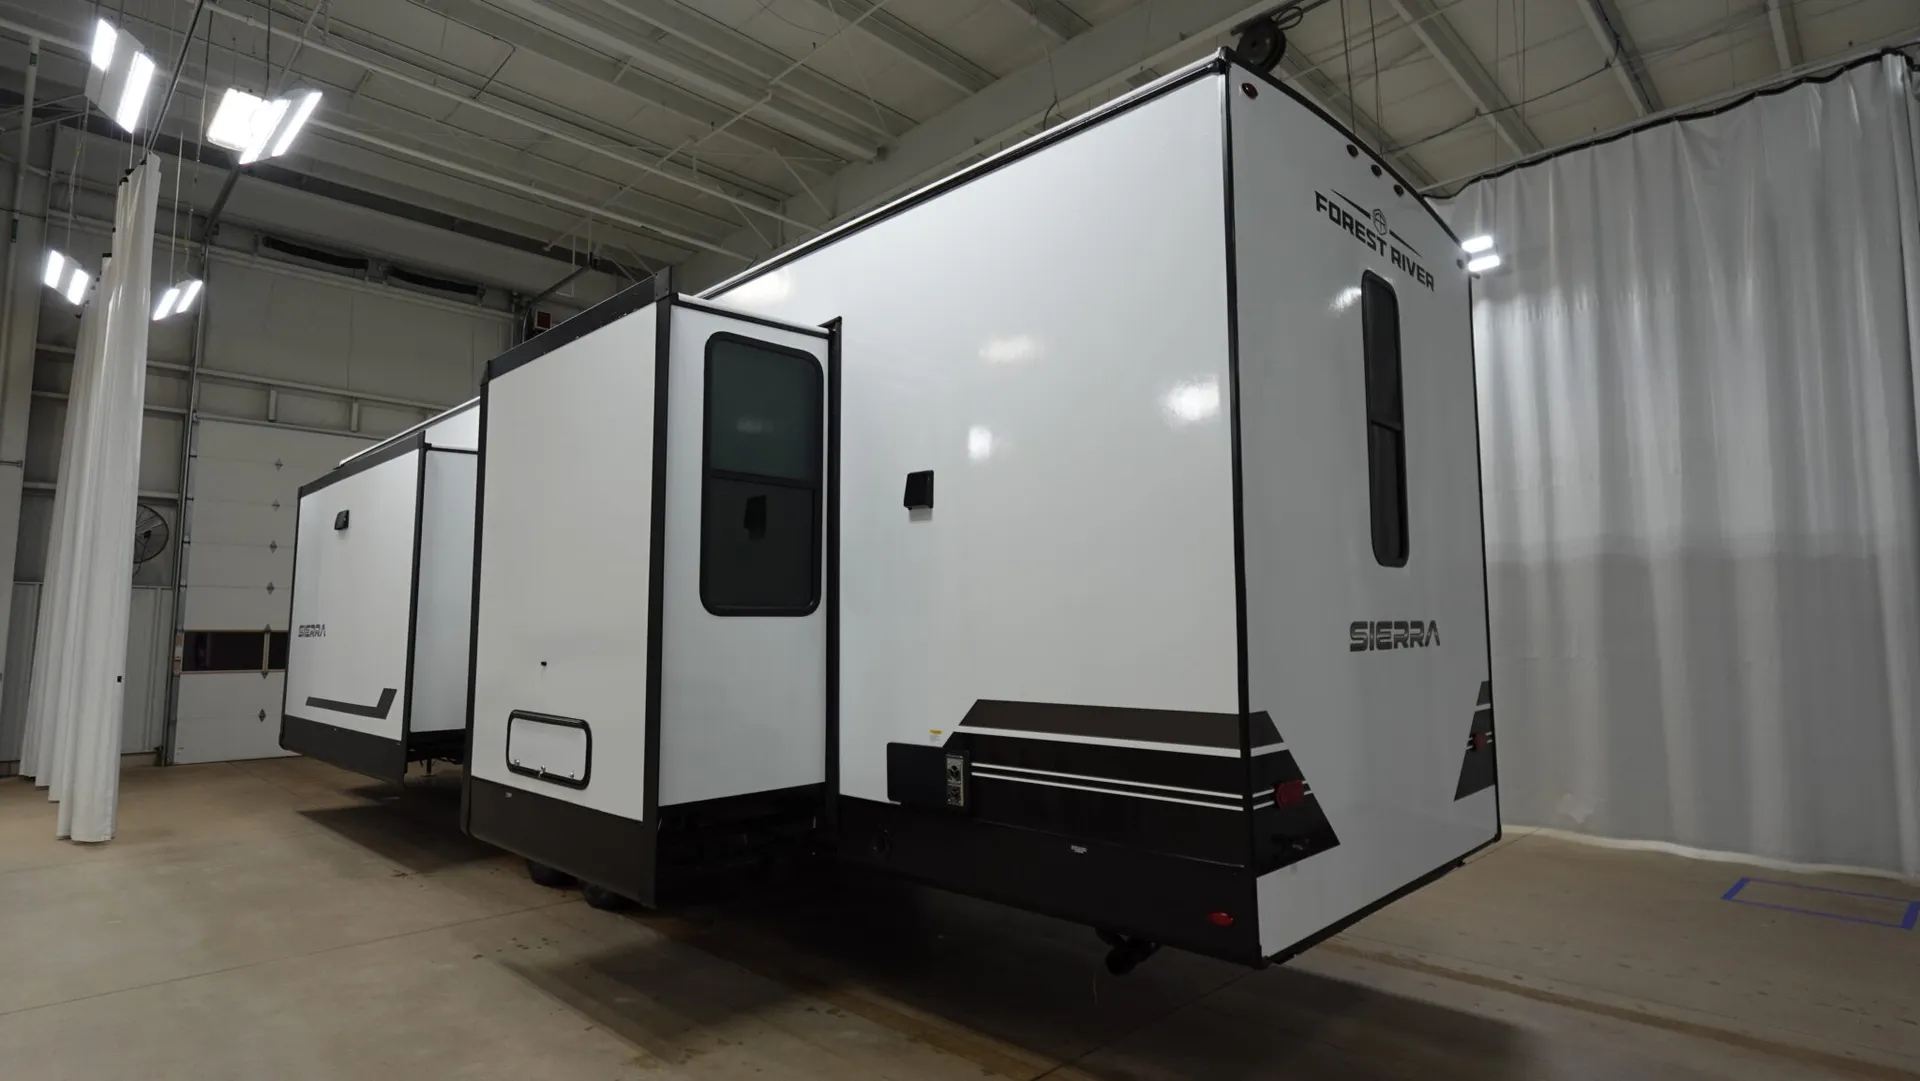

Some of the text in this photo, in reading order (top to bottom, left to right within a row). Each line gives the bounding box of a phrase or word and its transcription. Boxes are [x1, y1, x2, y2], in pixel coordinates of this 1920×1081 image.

[1314, 190, 1435, 292] FOREST RIVER
[298, 624, 326, 638] SIERRA
[1350, 620, 1440, 652] SIERRA
